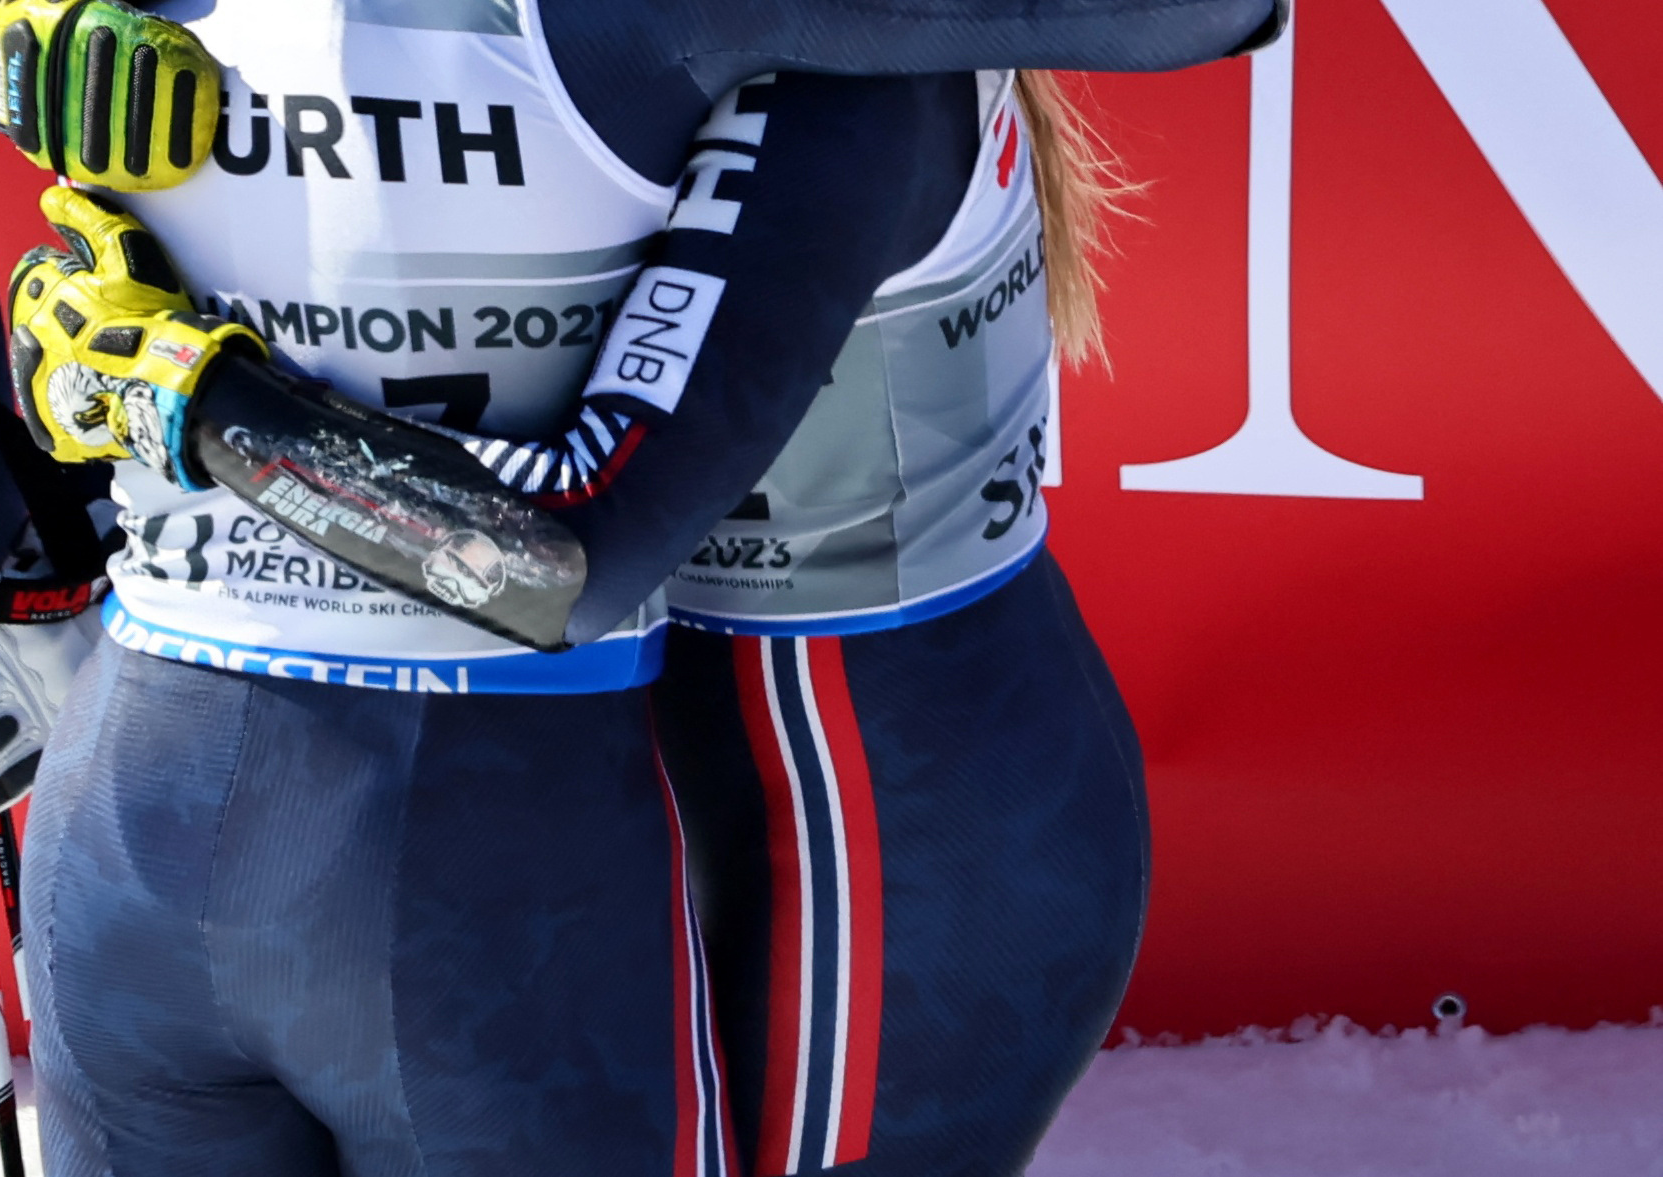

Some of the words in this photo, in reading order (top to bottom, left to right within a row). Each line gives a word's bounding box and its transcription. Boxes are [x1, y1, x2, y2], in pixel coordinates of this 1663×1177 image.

[616, 280, 696, 384] DNB
[243, 589, 298, 609] ALPINE
[303, 596, 363, 615] WORLD
[368, 603, 396, 616] SKI
